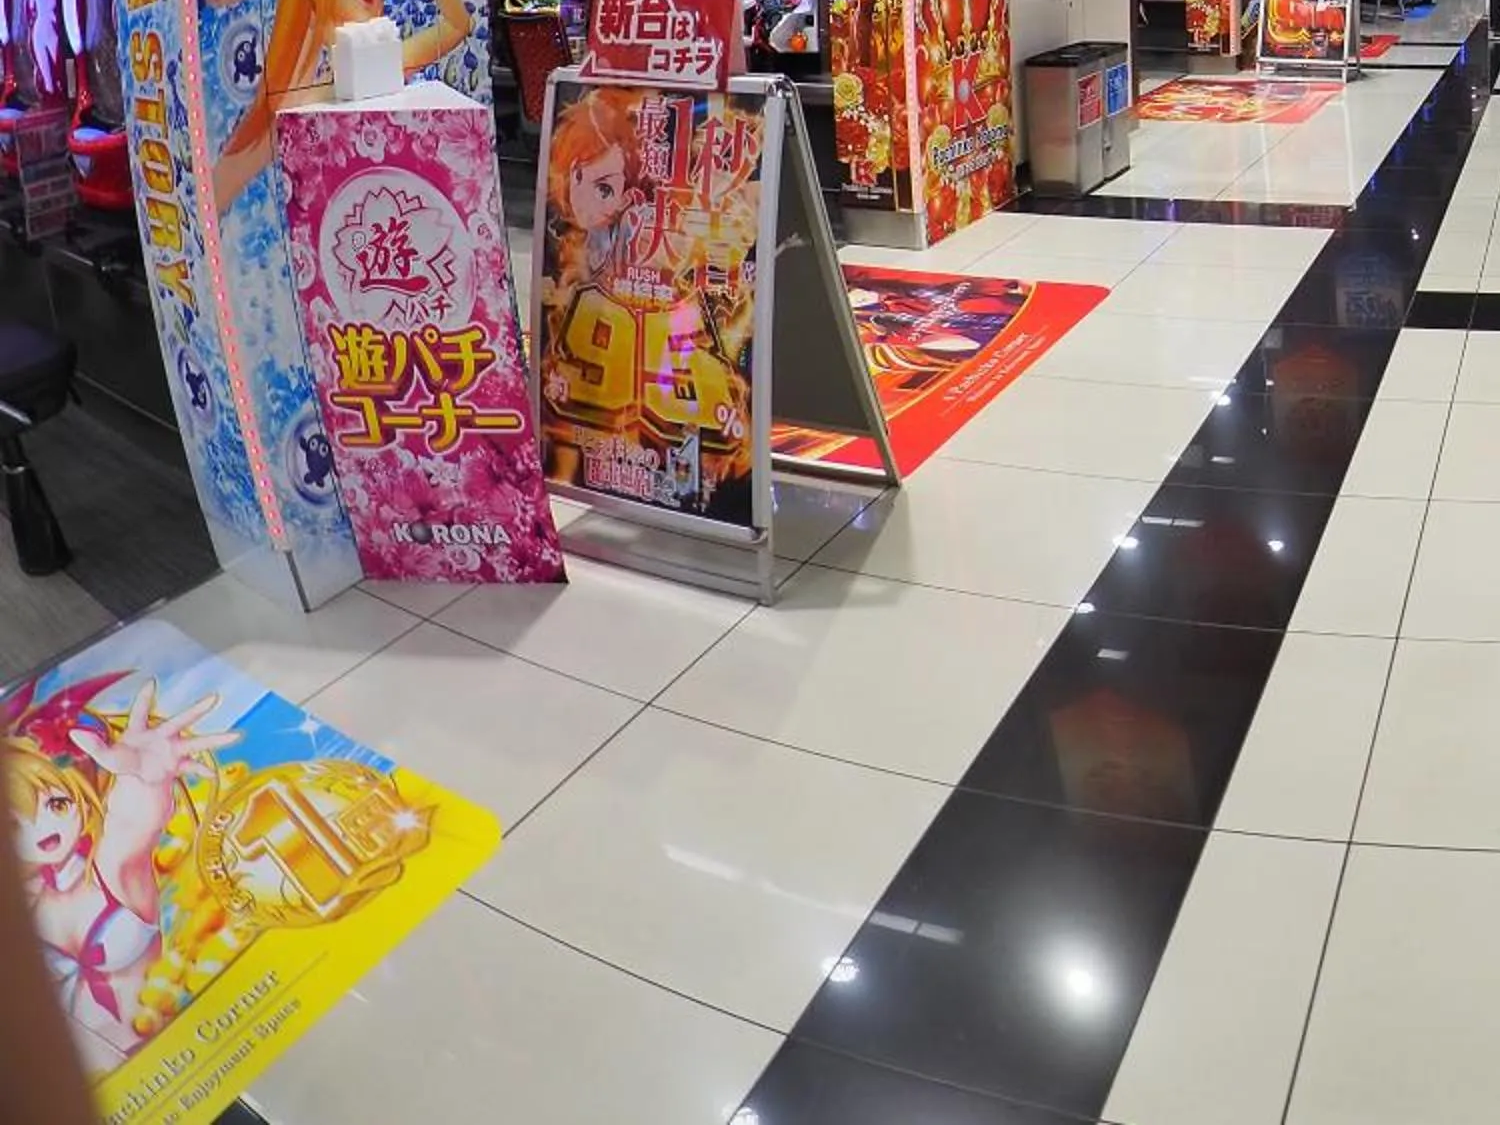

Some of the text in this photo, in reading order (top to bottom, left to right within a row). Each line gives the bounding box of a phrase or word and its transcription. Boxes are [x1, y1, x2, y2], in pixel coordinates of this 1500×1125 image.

[651, 41, 721, 76] コチラ
[130, 32, 198, 316] STORY
[355, 216, 432, 295] 遊
[627, 266, 662, 284] RUSH
[331, 322, 496, 397] 遊パチ
[329, 390, 524, 454] コーナー
[100, 969, 281, 1125] achinko Corner
[176, 1038, 257, 1112] Enjoyment
